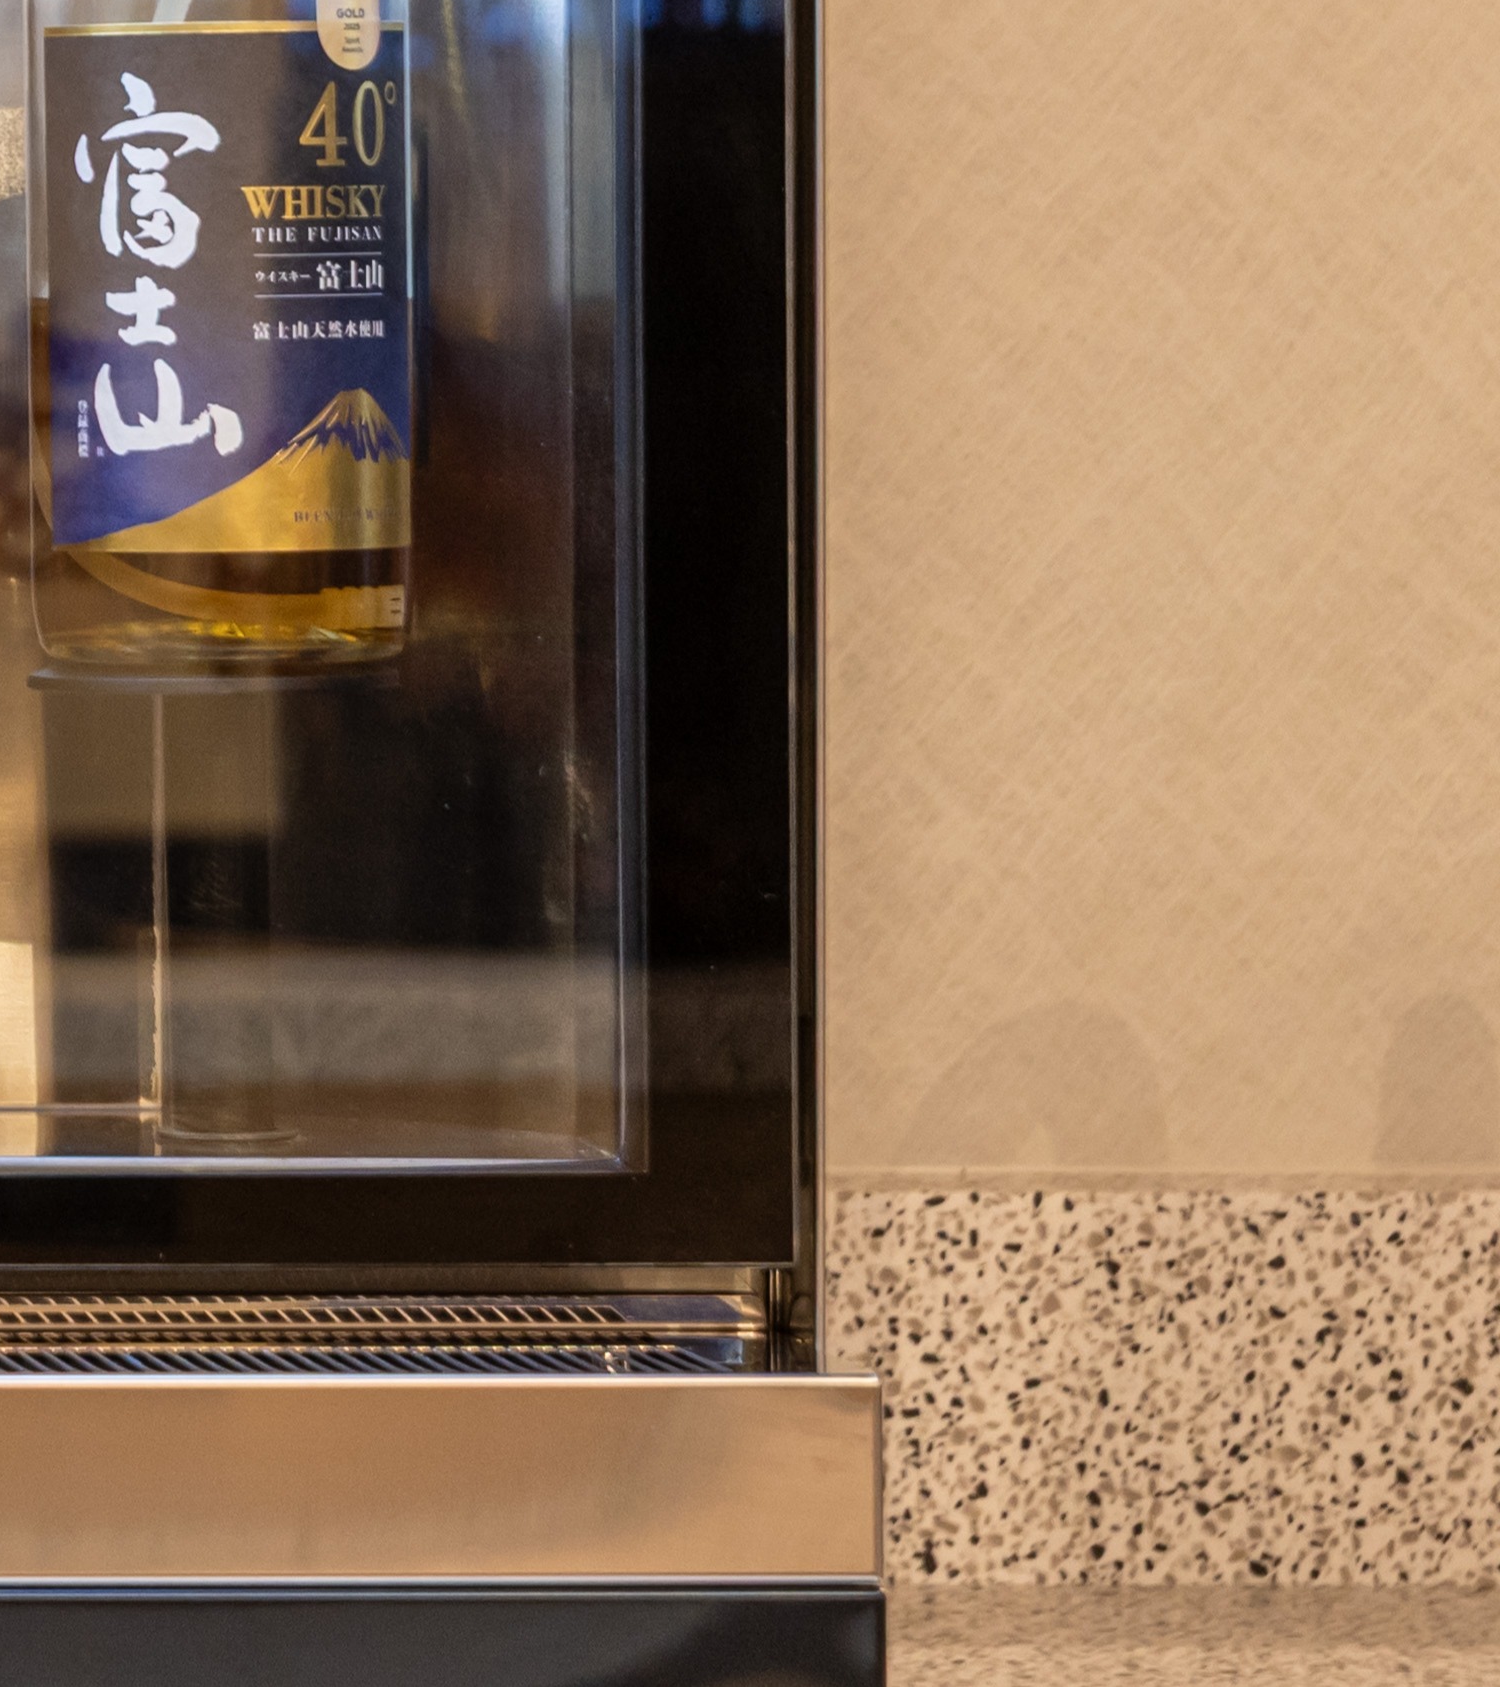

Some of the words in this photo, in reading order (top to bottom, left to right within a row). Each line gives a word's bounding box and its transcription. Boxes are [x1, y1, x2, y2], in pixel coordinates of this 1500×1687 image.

[336, 7, 365, 19] GOLD
[241, 184, 385, 220] WHISKY
[252, 227, 296, 243] THE
[307, 226, 382, 243] FUJISAN
[75, 71, 243, 457] 富士山
[254, 269, 311, 283] ウイスキー
[316, 260, 384, 292] 富士山
[252, 319, 384, 340] 富士山天然水使用
